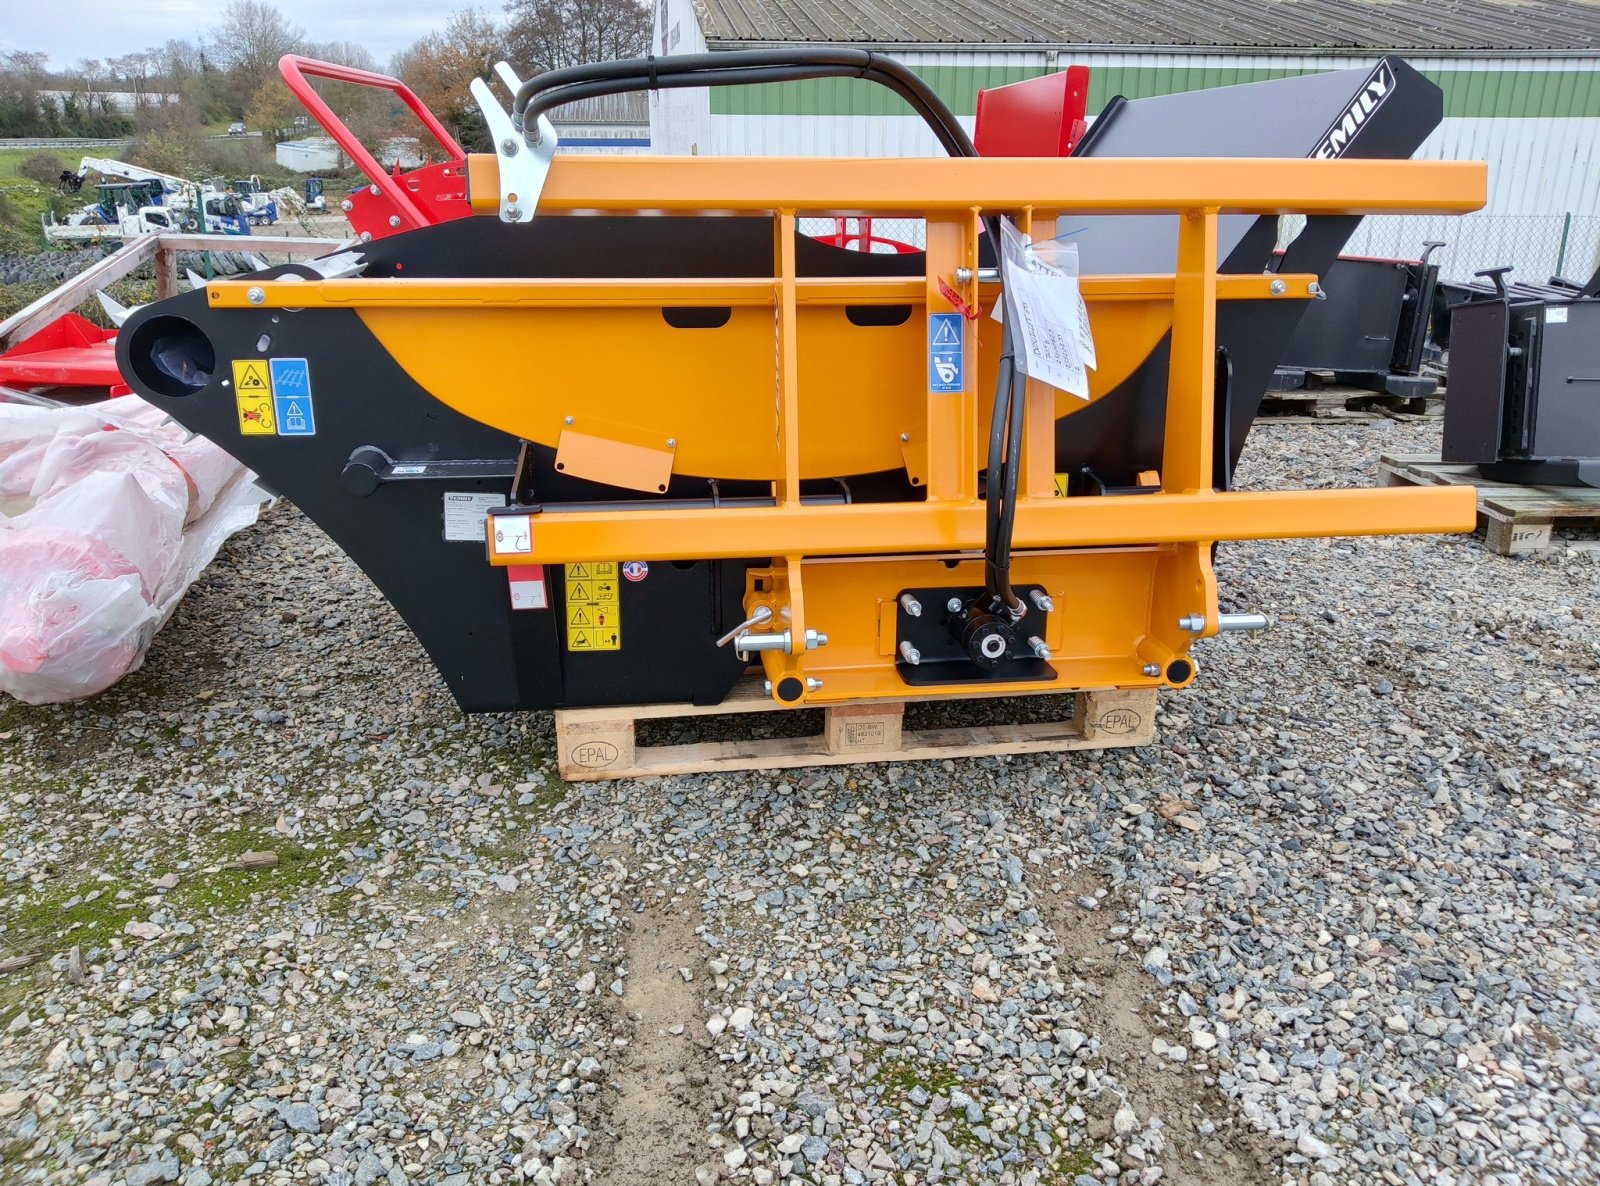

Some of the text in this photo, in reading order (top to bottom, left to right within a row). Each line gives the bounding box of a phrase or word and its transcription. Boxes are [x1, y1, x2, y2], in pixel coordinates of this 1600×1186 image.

[1315, 68, 1387, 160] EMILY
[1105, 714, 1135, 729] EPAL
[579, 746, 612, 763] EPAL
